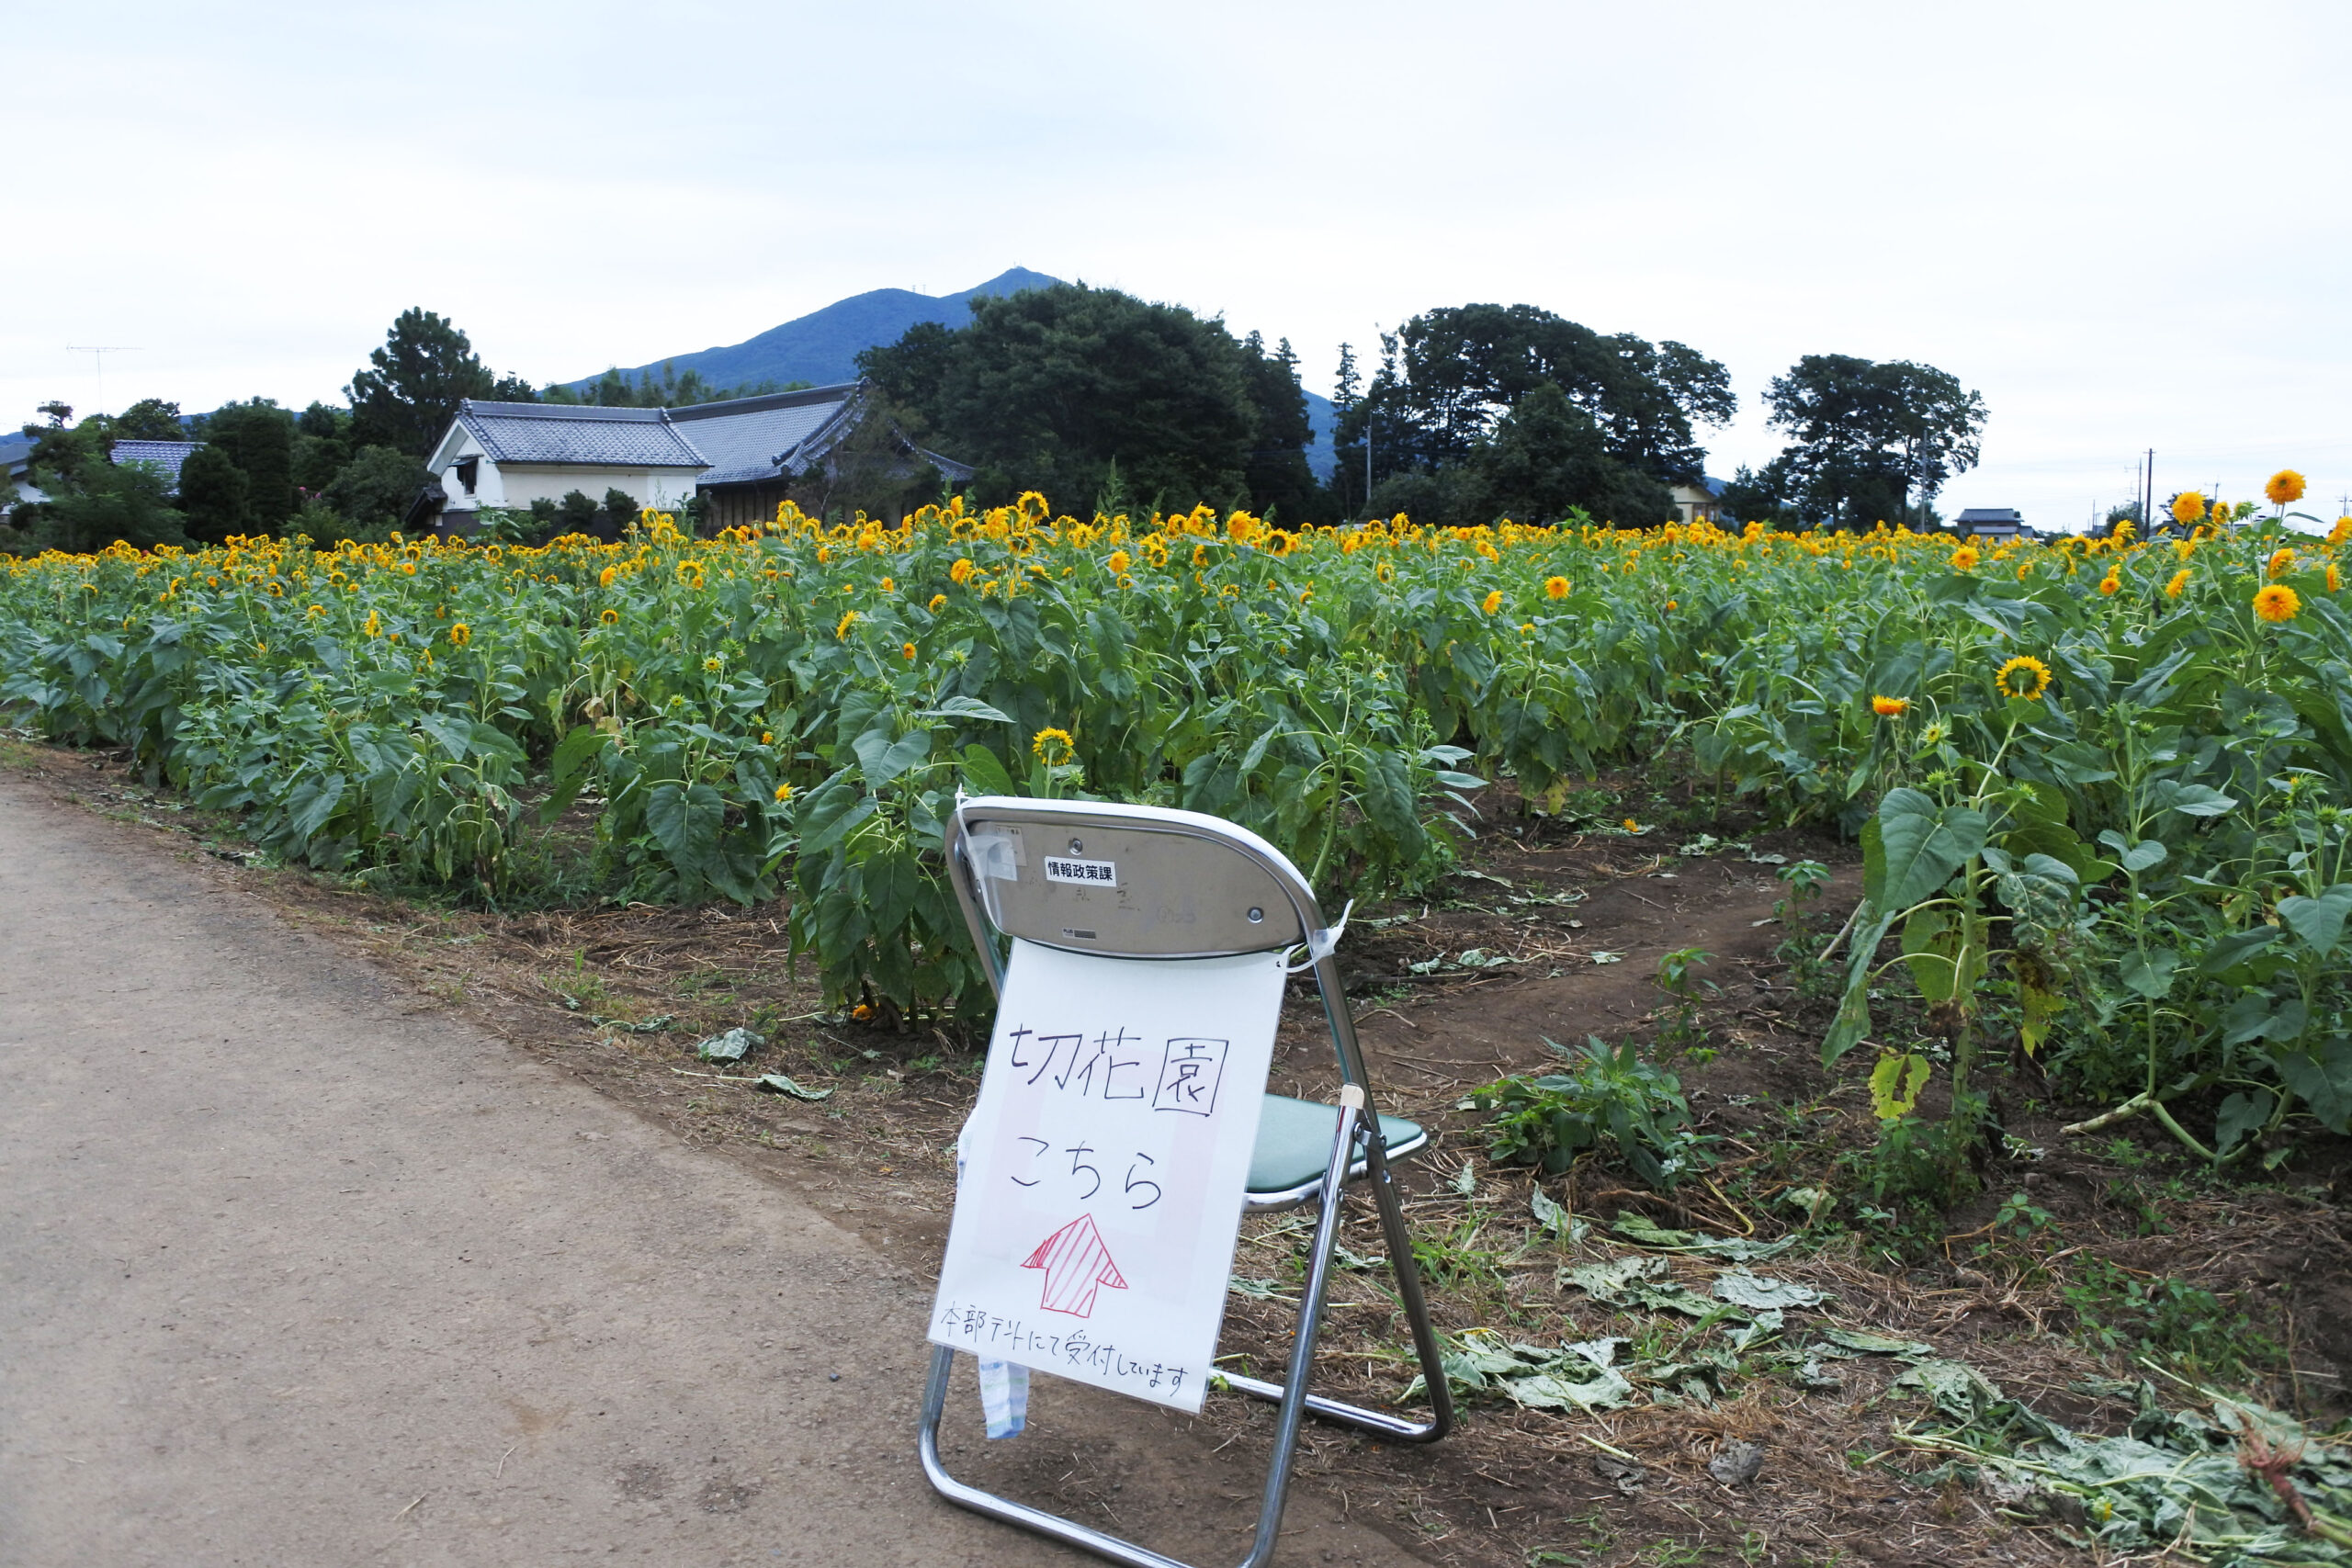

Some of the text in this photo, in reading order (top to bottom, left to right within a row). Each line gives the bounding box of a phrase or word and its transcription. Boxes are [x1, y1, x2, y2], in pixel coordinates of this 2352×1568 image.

[1048, 861, 1113, 881] 情報政策課
[1010, 1023, 1229, 1117] 切花園
[1011, 1136, 1161, 1210] こちら
[940, 1301, 1189, 1397] 本部テントにて受付しています
